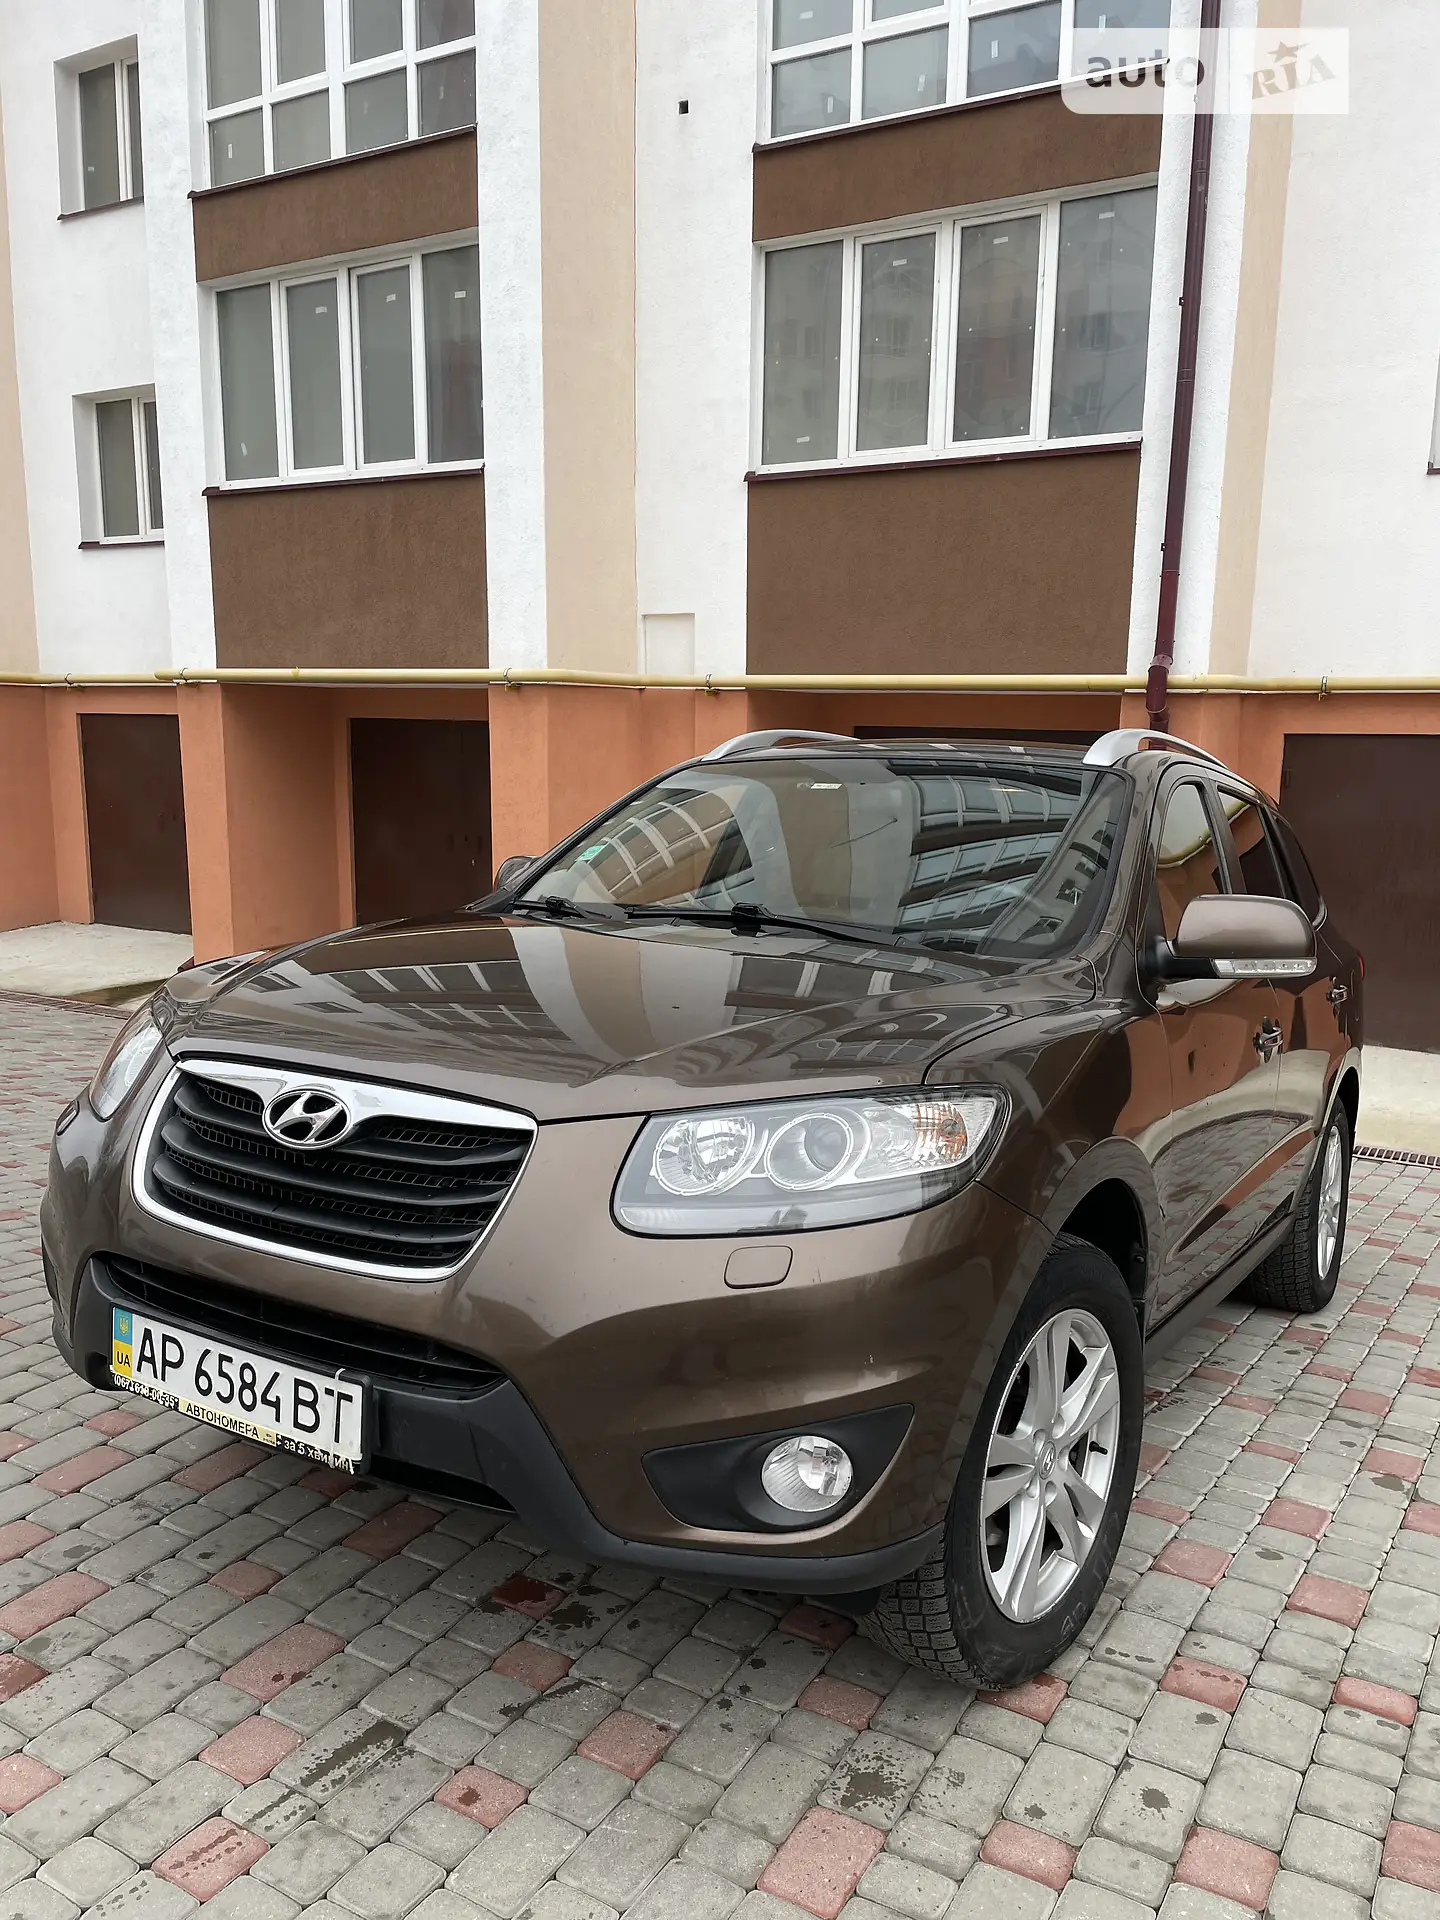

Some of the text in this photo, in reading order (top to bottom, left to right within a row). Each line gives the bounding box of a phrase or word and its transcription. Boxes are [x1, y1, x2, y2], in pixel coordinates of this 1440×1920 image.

[116, 1350, 131, 1368] UA
[136, 1327, 354, 1444] AP 6584 BT
[185, 1402, 260, 1439] АВТОНОМЕРА
